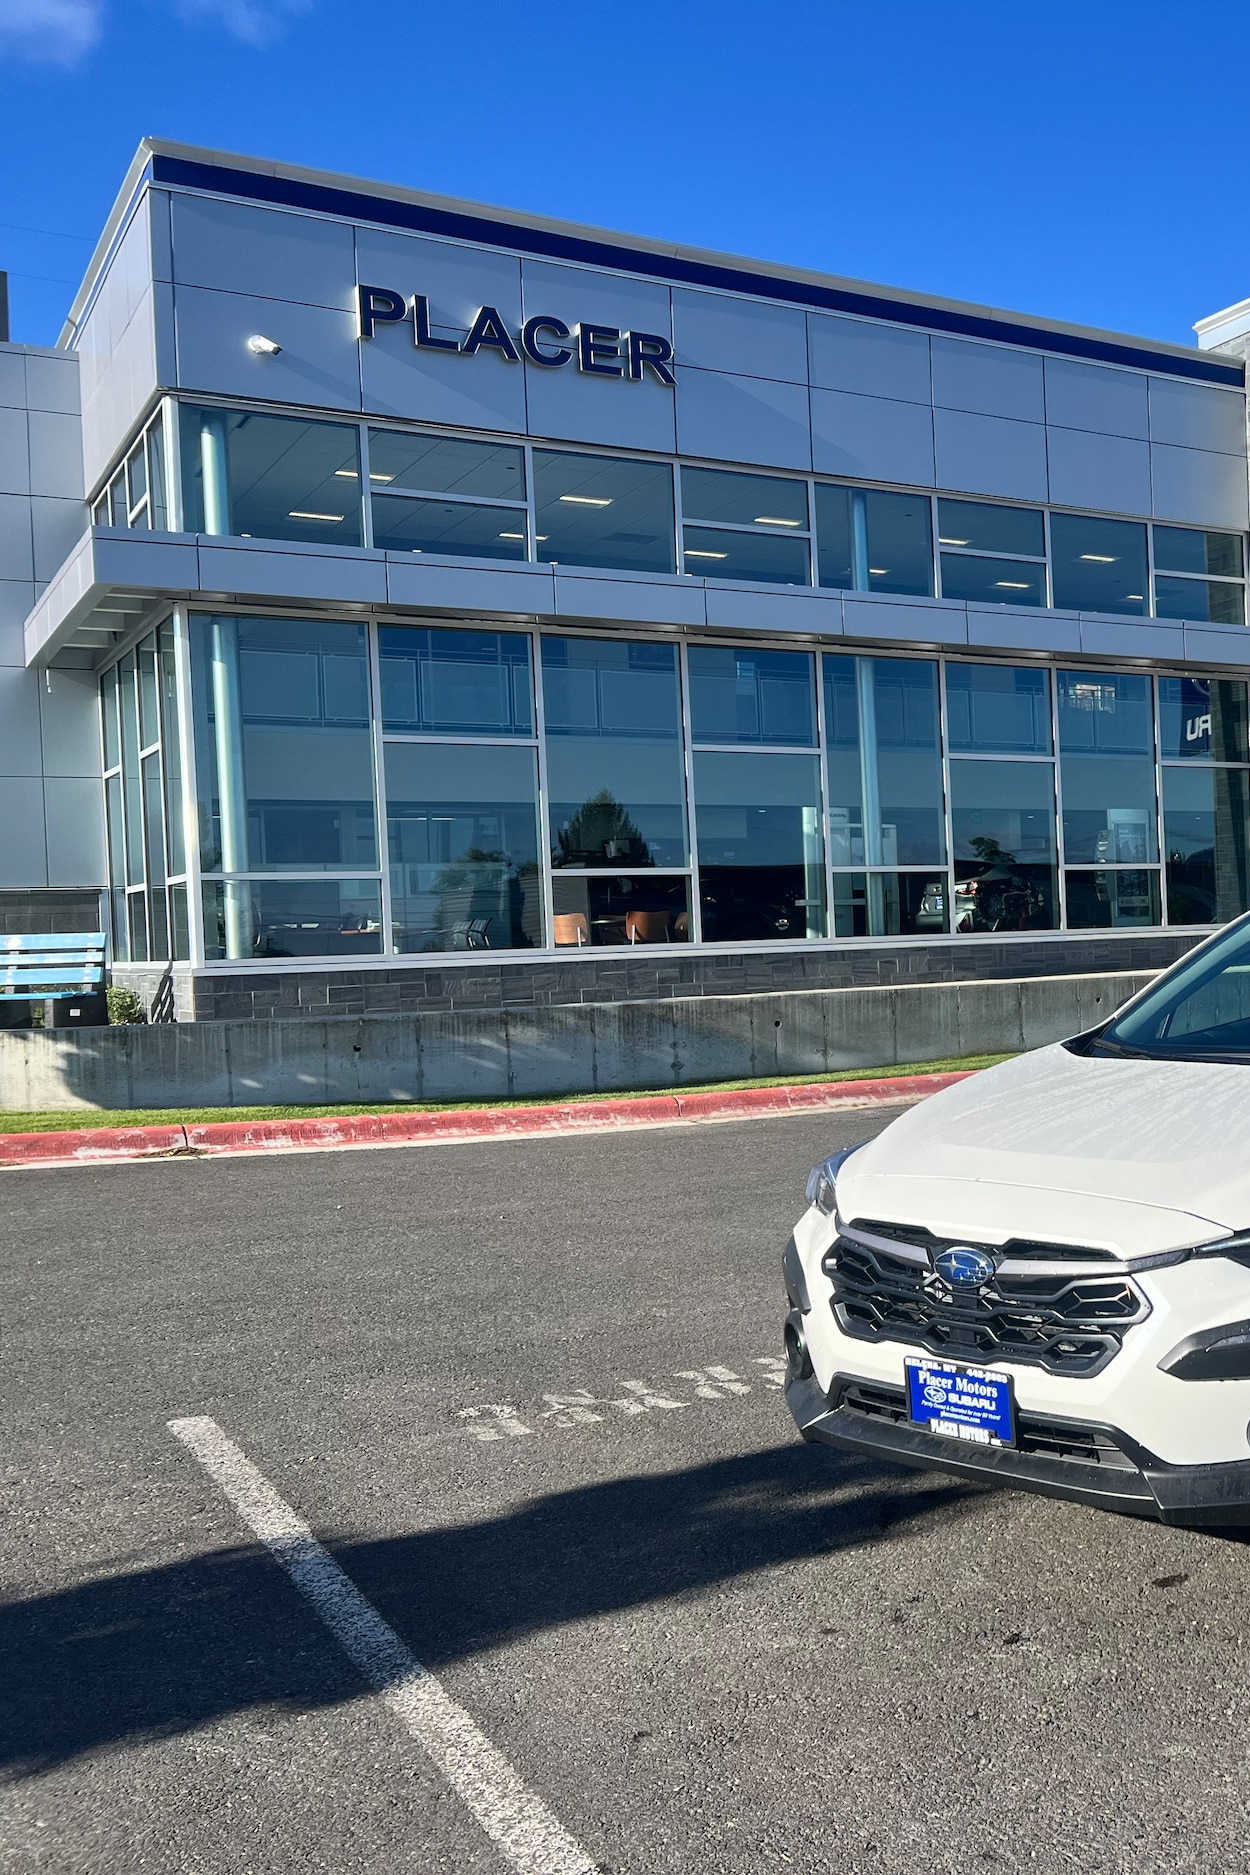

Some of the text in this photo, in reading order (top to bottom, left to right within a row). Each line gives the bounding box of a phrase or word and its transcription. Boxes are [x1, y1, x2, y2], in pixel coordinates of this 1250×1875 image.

[356, 284, 677, 386] PLACER
[918, 1370, 998, 1398] Placer Motors
[948, 1393, 996, 1411] SUBARU
[940, 1410, 981, 1424] placermotors.com
[930, 1418, 959, 1438] PLACER
[959, 1424, 989, 1444] MOTORS
